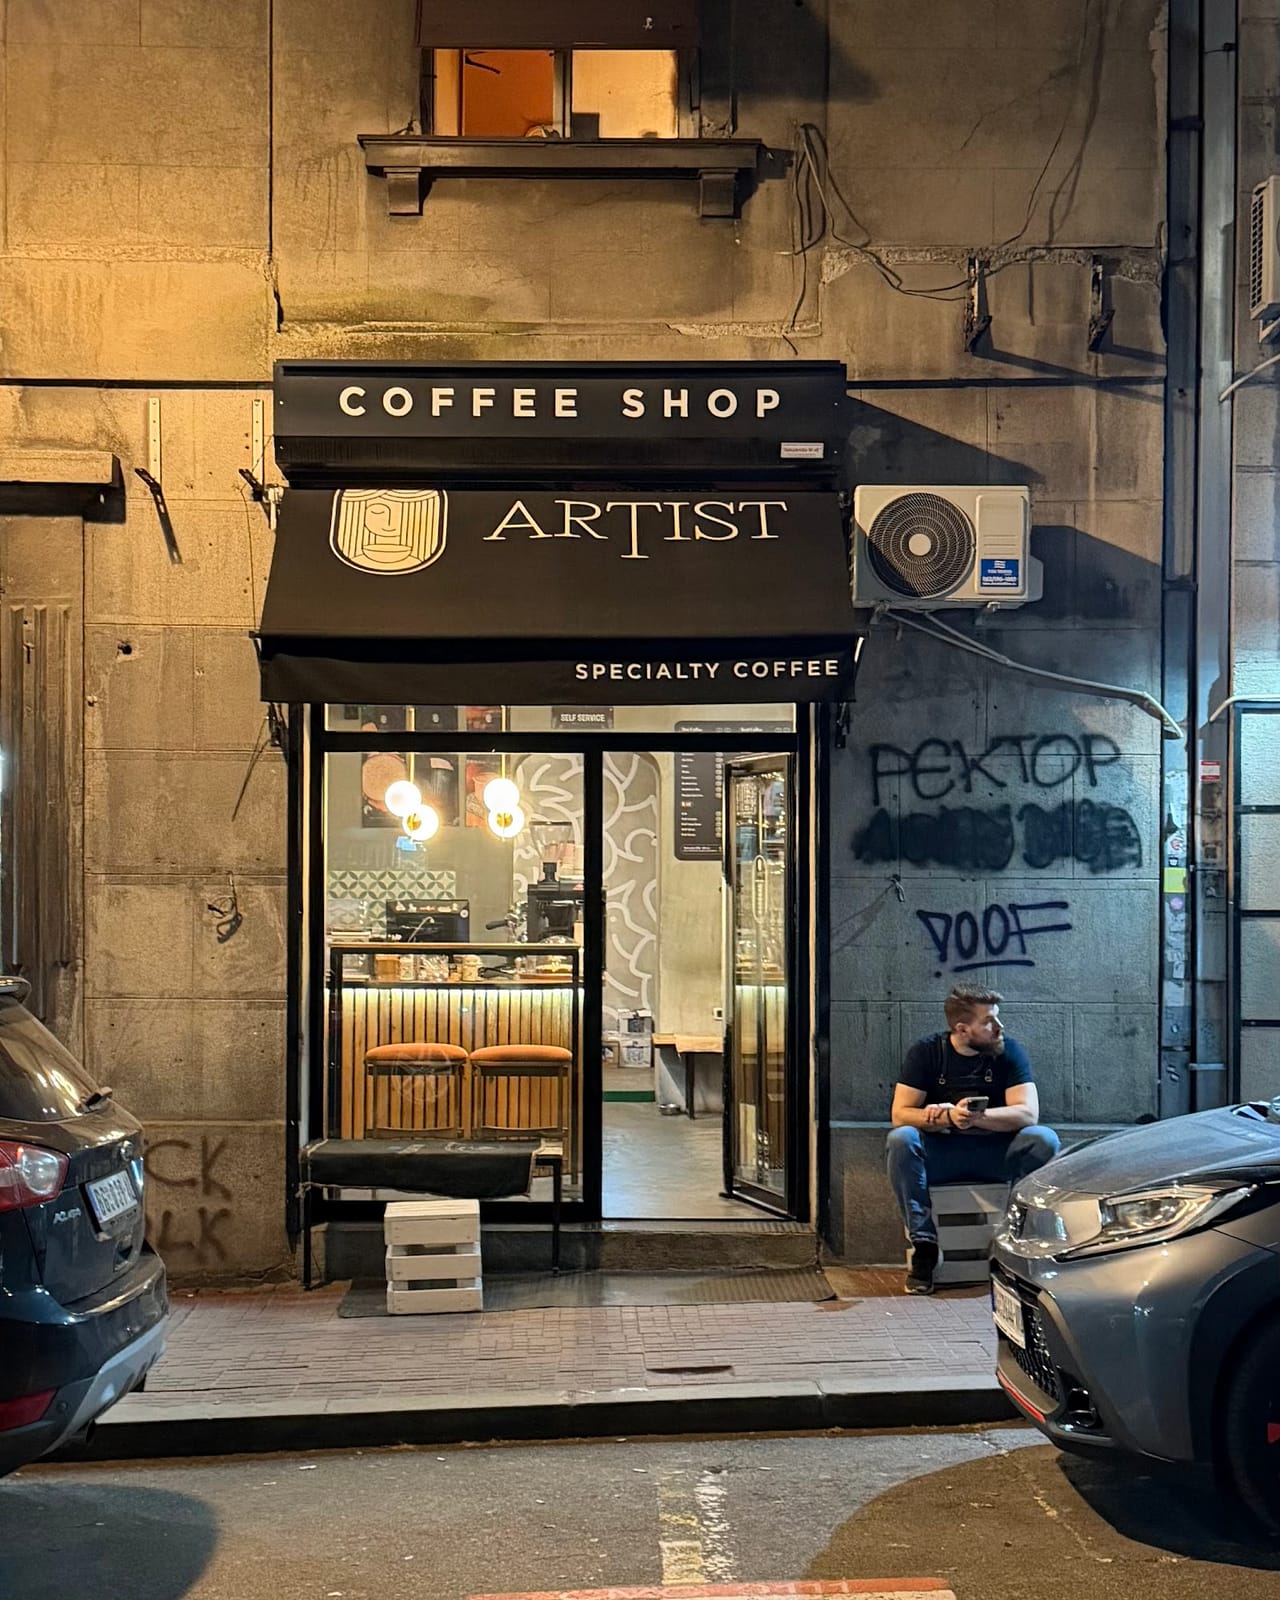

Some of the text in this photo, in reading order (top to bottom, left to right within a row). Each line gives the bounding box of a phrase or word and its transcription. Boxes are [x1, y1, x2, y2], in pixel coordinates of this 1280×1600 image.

[339, 385, 780, 418] COFFEE SHOP
[483, 499, 788, 559] ARTIST
[575, 659, 839, 680] SPECIALTY COFFEE
[560, 713, 606, 722] SELF SERVICE
